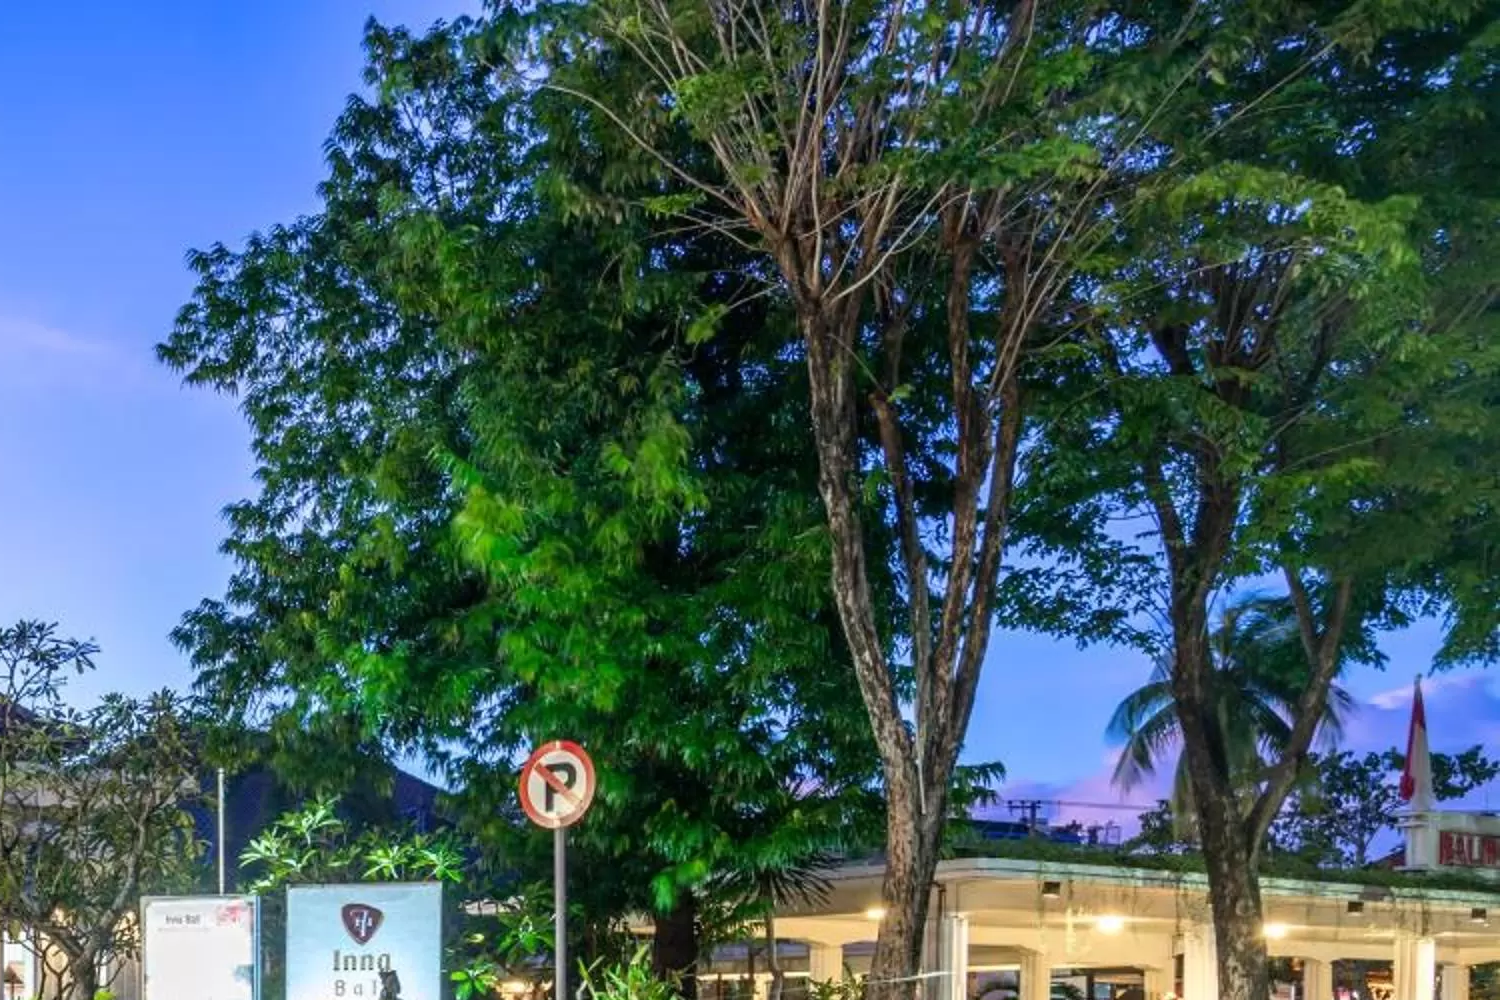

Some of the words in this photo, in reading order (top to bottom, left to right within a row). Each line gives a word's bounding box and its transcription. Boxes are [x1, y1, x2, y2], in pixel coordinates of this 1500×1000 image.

[544, 762, 577, 812] P
[332, 950, 391, 972] Inna
[334, 979, 379, 997] Bal
